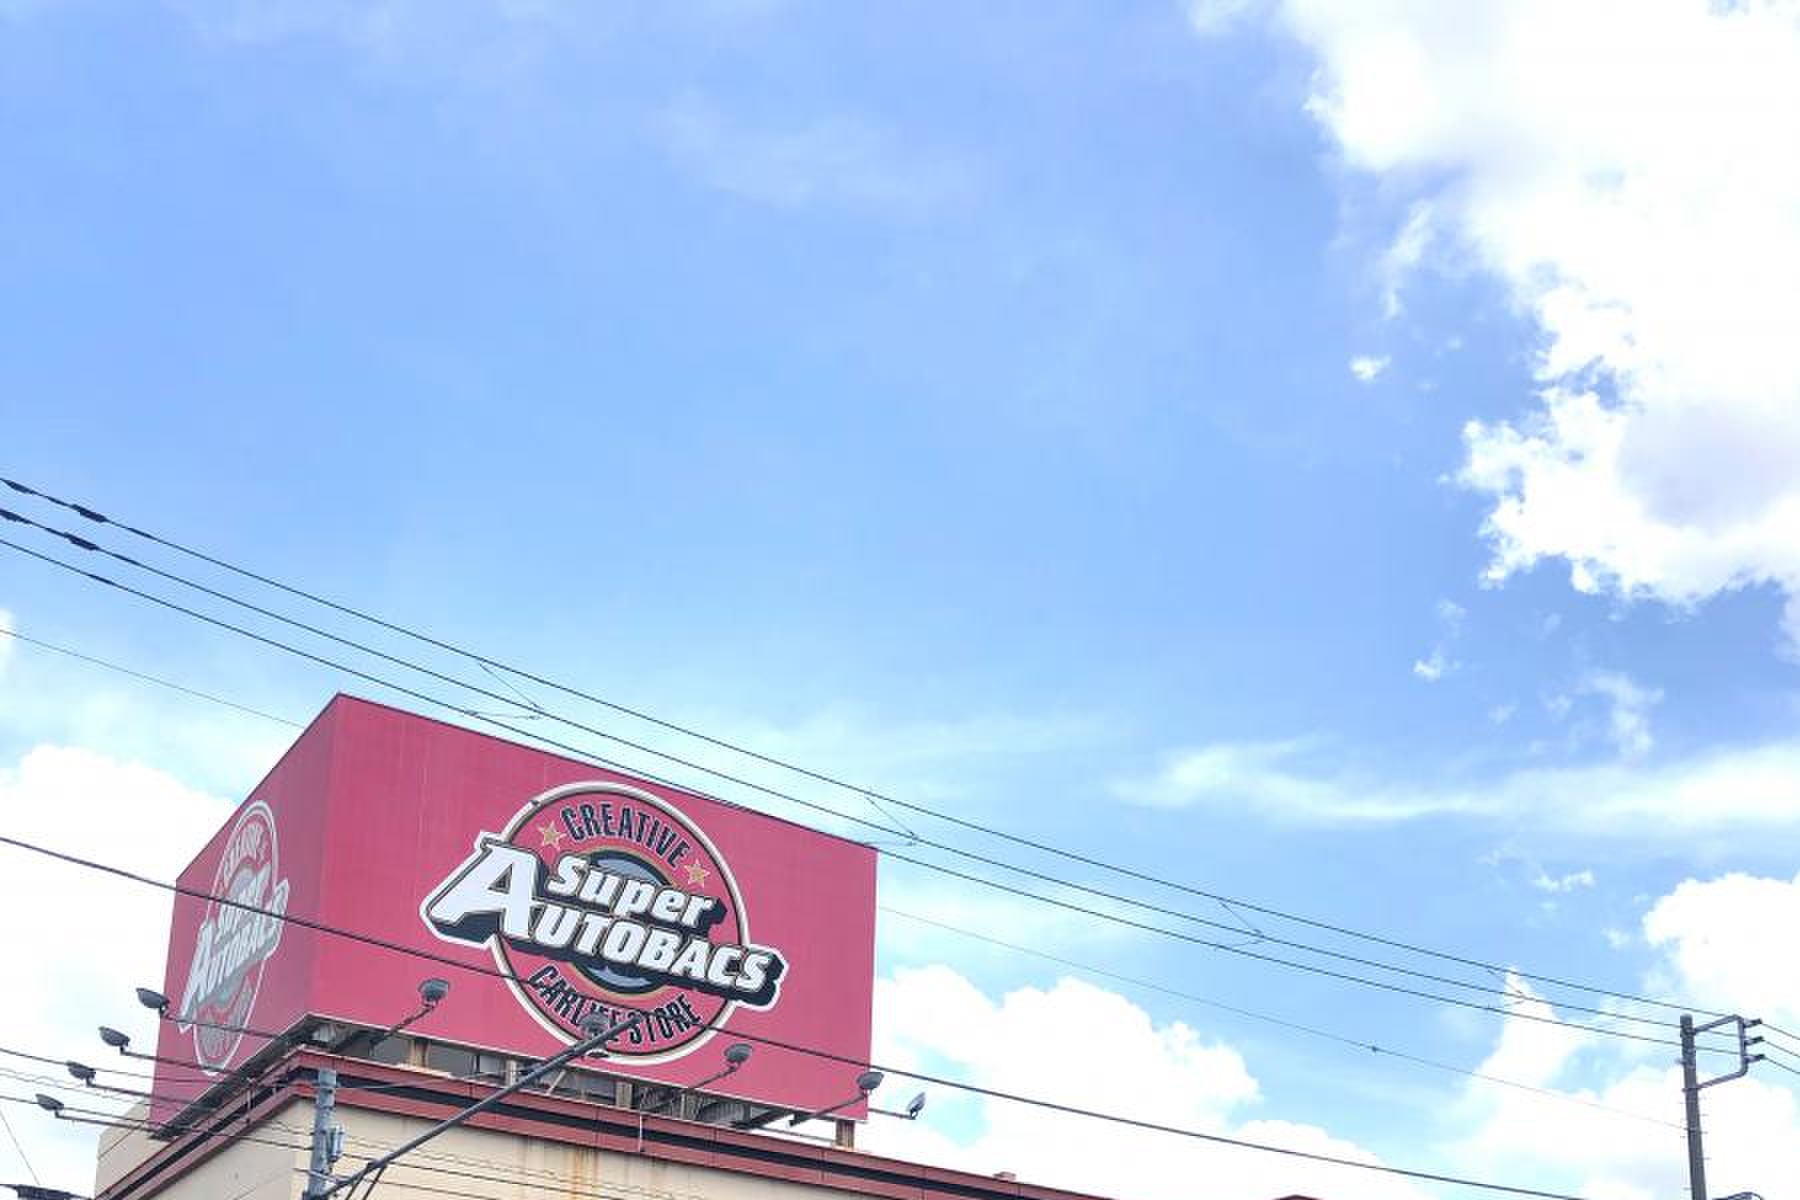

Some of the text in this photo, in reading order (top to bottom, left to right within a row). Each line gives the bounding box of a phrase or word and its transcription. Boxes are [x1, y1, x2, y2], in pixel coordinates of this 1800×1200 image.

[560, 803, 690, 868] CREATIVE
[430, 844, 772, 994] AUTOBACS
[547, 854, 714, 928] Super
